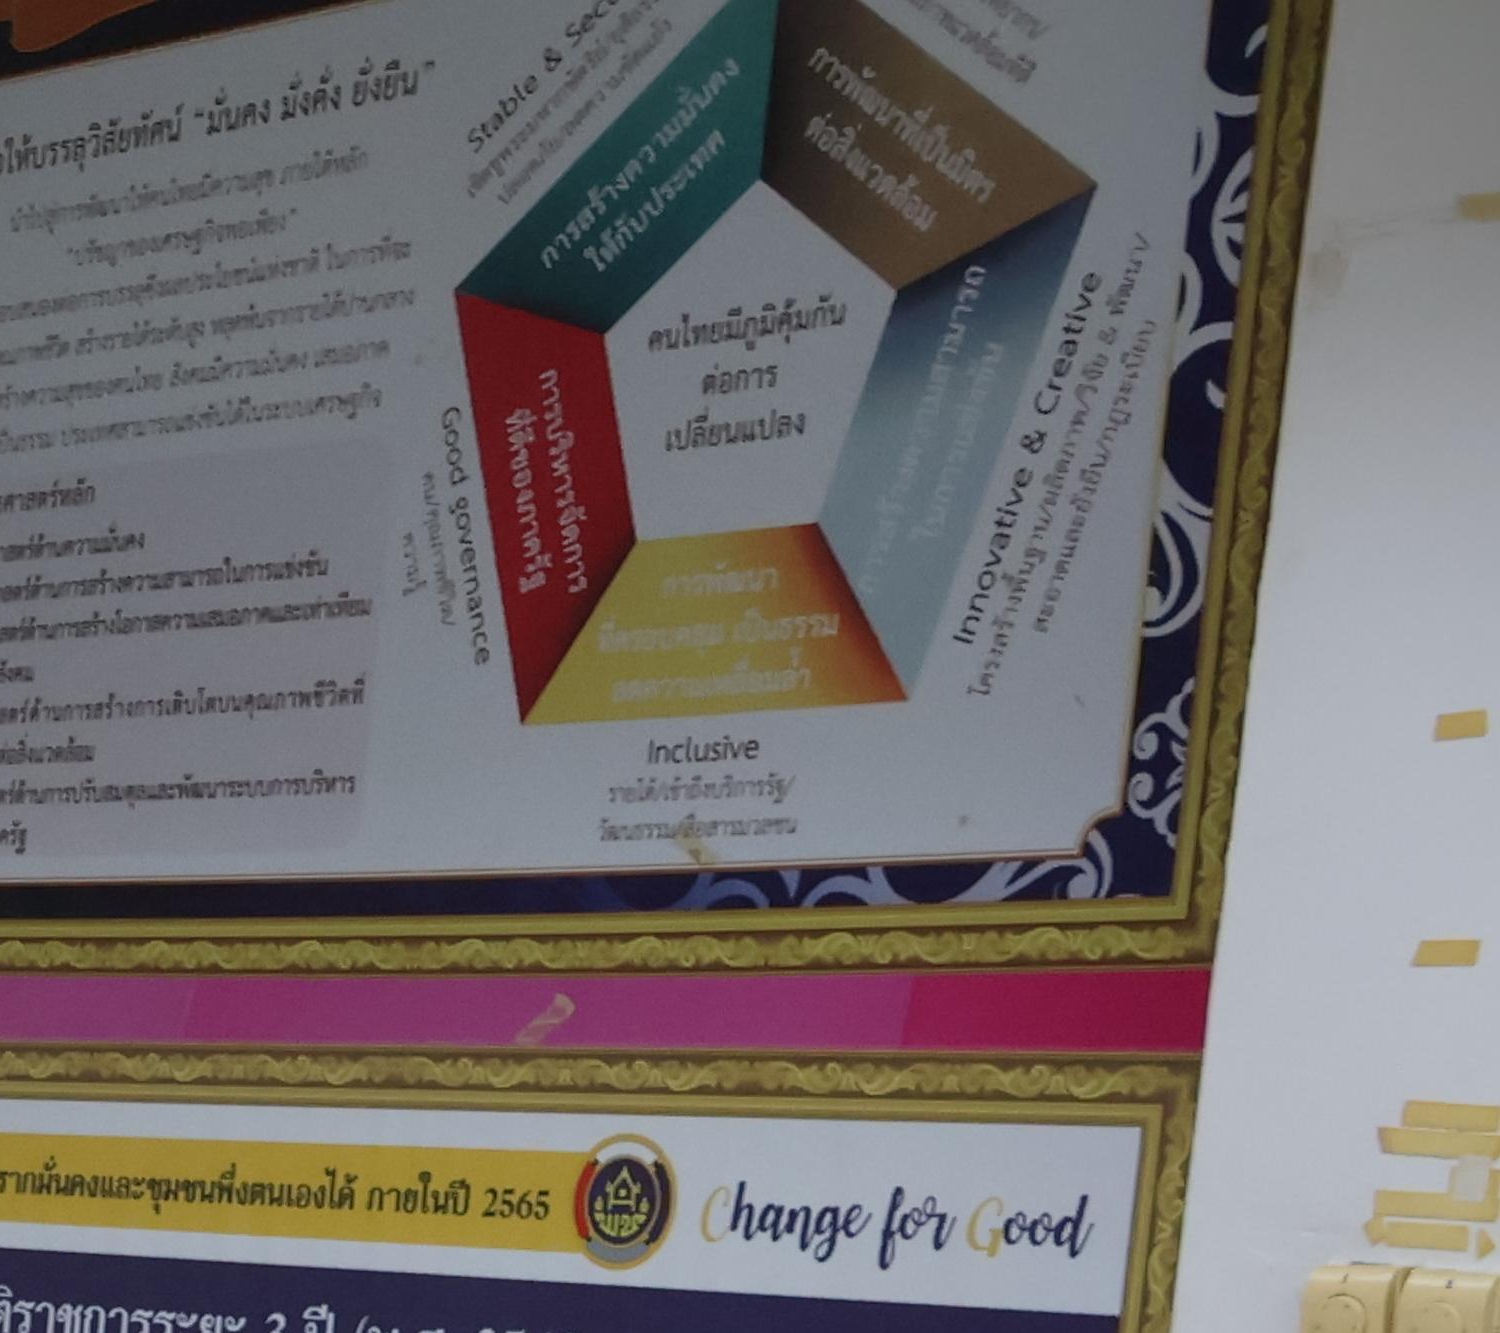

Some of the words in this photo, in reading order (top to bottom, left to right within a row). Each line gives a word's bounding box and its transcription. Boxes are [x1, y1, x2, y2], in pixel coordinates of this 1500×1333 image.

[466, 74, 540, 155] Stable
[542, 46, 564, 74] &
[564, 0, 618, 48] Sec
[439, 406, 470, 488] Good
[951, 466, 1038, 647] Innovative
[1020, 431, 1046, 457] &
[1033, 270, 1104, 418] Creative
[448, 494, 491, 667] governance
[647, 735, 761, 766] Inclusive
[366, 1171, 471, 1216] ภายในปี
[481, 1188, 551, 1222] 2565
[700, 1181, 872, 1263] Change
[878, 1185, 956, 1271] for
[966, 1194, 1094, 1259] Good
